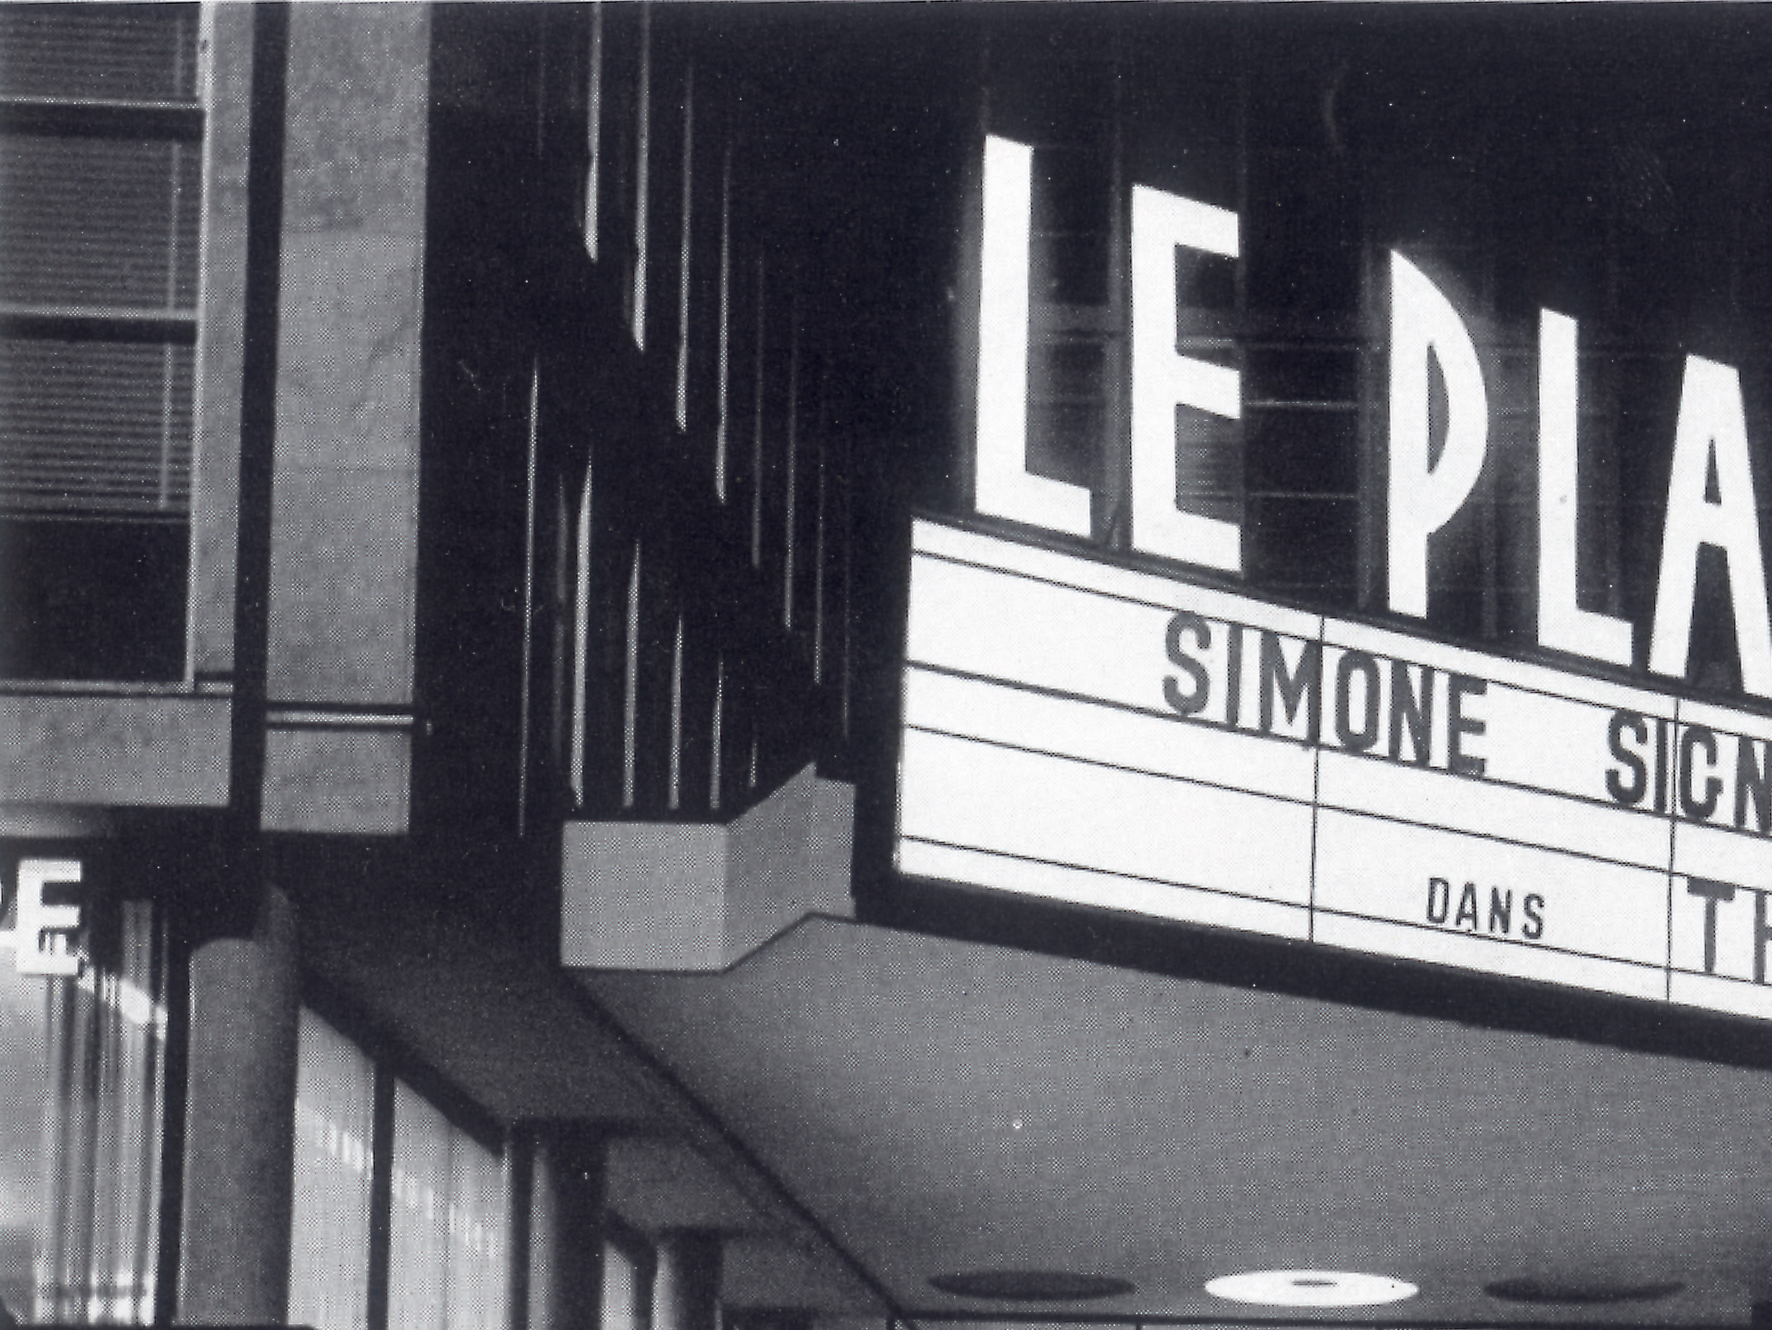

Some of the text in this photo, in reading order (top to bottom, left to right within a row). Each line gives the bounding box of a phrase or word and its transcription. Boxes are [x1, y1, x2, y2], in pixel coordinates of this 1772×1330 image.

[975, 134, 1242, 572] LE
[1164, 611, 1488, 776] SIMONE
[1427, 877, 1546, 941] DANS
